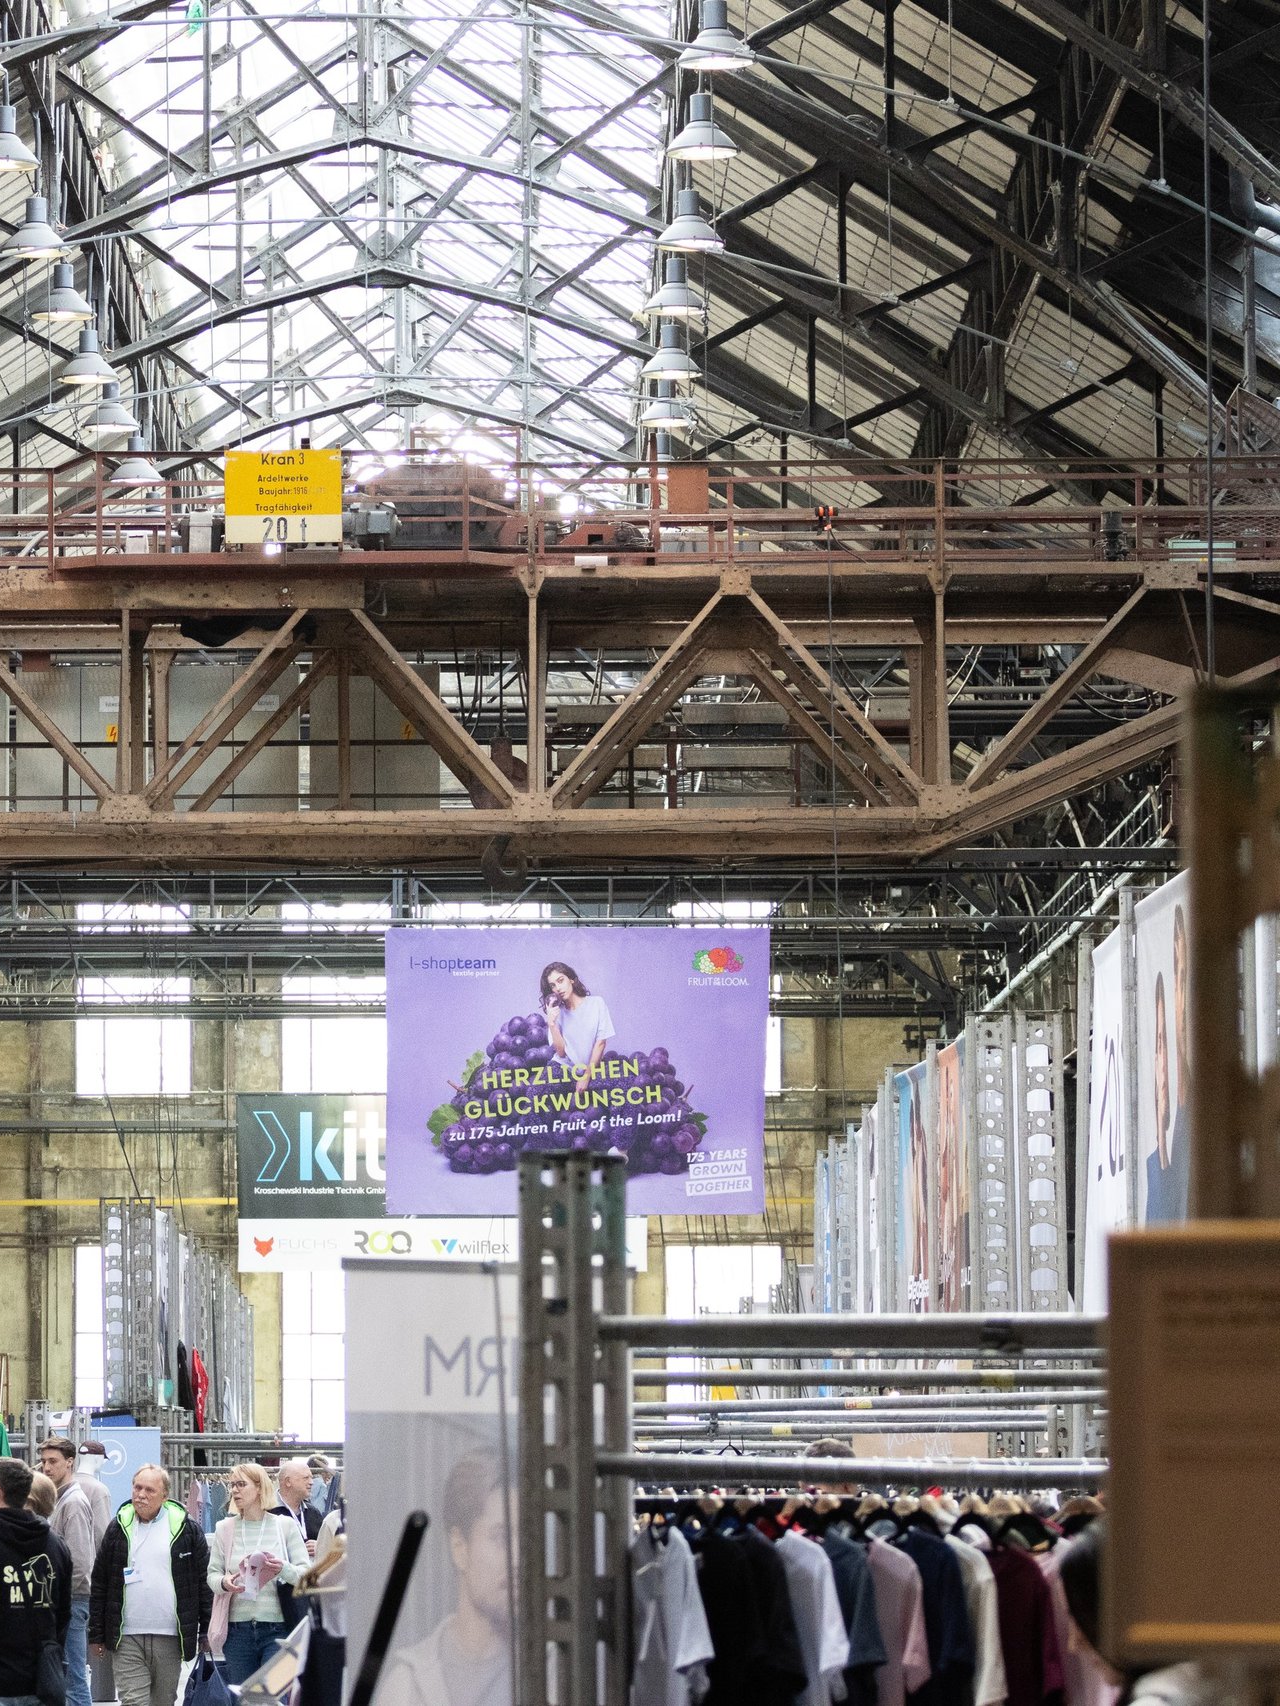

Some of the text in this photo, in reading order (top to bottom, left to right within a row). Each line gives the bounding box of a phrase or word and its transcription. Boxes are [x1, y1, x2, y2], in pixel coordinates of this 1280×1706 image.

[261, 452, 305, 466] Kran 3
[257, 474, 309, 483] Ardeltwerke
[255, 503, 313, 513] Tragfähigkeit
[262, 516, 307, 542] 20 t
[687, 976, 714, 986] FRUIT
[481, 1058, 640, 1090] HERZLICHEN
[464, 1084, 662, 1119] GLÜCKWUNSCH
[449, 1109, 682, 1142] zu 175 Jahren Fruit of the Loom!
[299, 1110, 387, 1181] kit
[686, 1148, 748, 1163] 175 YEARS
[692, 1163, 743, 1176] GROWN
[254, 1187, 301, 1195] Kroschewski
[302, 1187, 334, 1195] Industrie
[335, 1187, 364, 1195] Technik
[688, 1179, 750, 1194] TOGETHER
[278, 1238, 338, 1250] FUCHS
[354, 1230, 412, 1254] ROQ
[458, 1240, 510, 1254] wilflex
